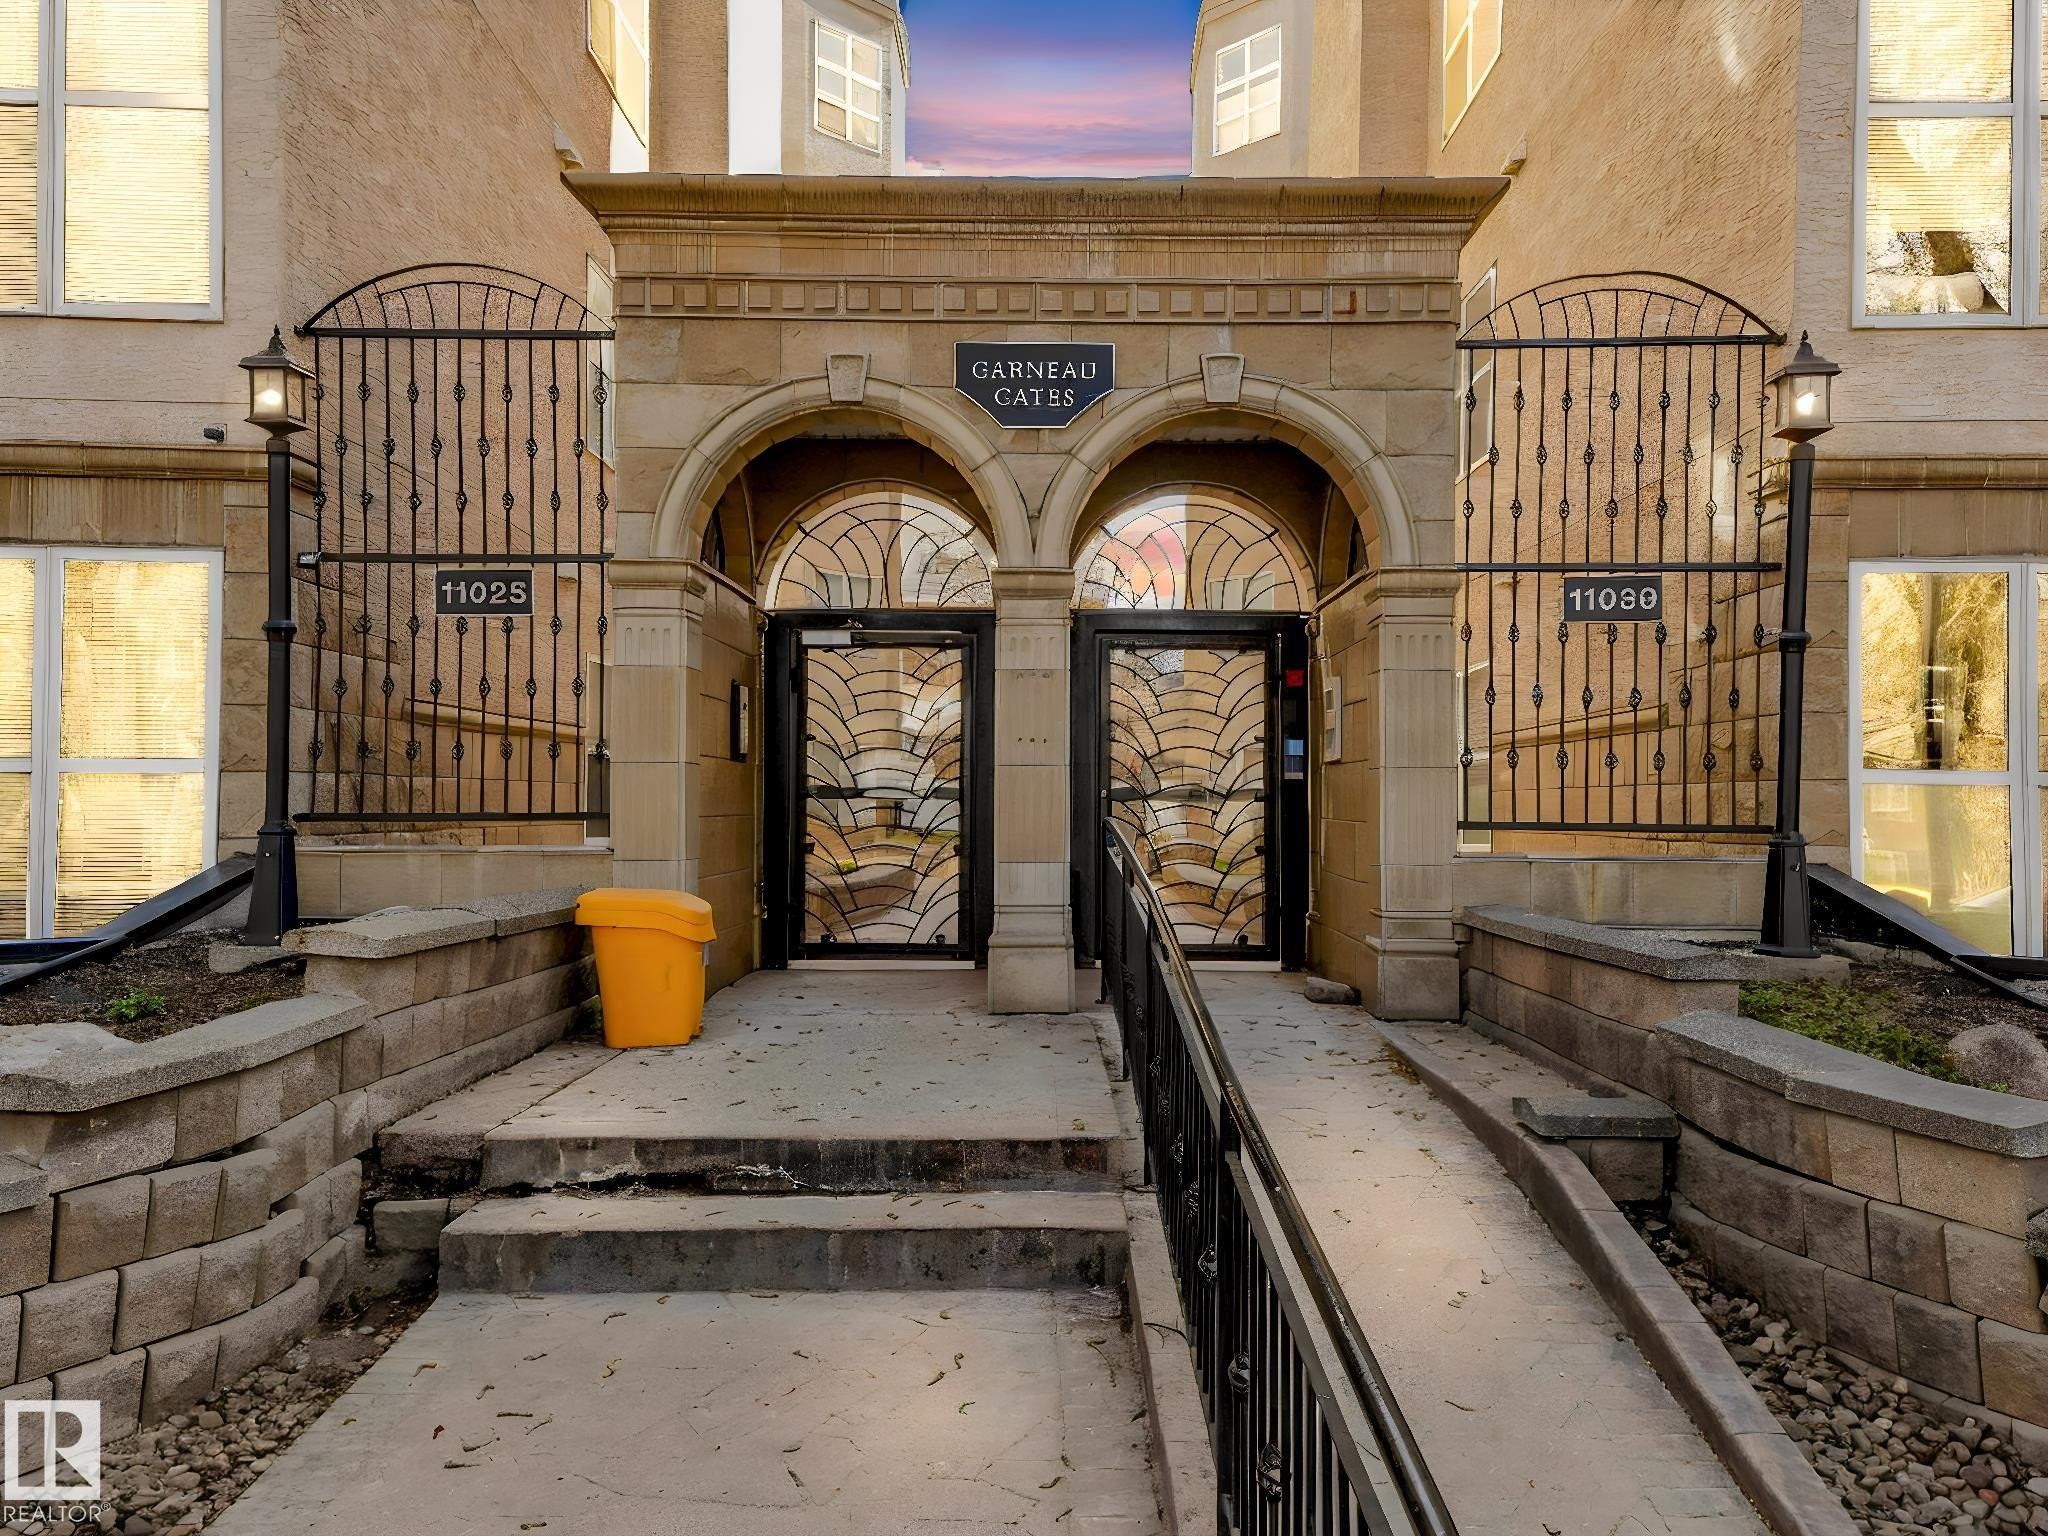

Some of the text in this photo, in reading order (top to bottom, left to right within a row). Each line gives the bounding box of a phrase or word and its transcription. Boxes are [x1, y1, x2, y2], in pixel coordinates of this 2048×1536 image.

[972, 361, 1096, 379] GARNEAU
[994, 388, 1075, 407] GATES
[441, 581, 527, 604] 11025
